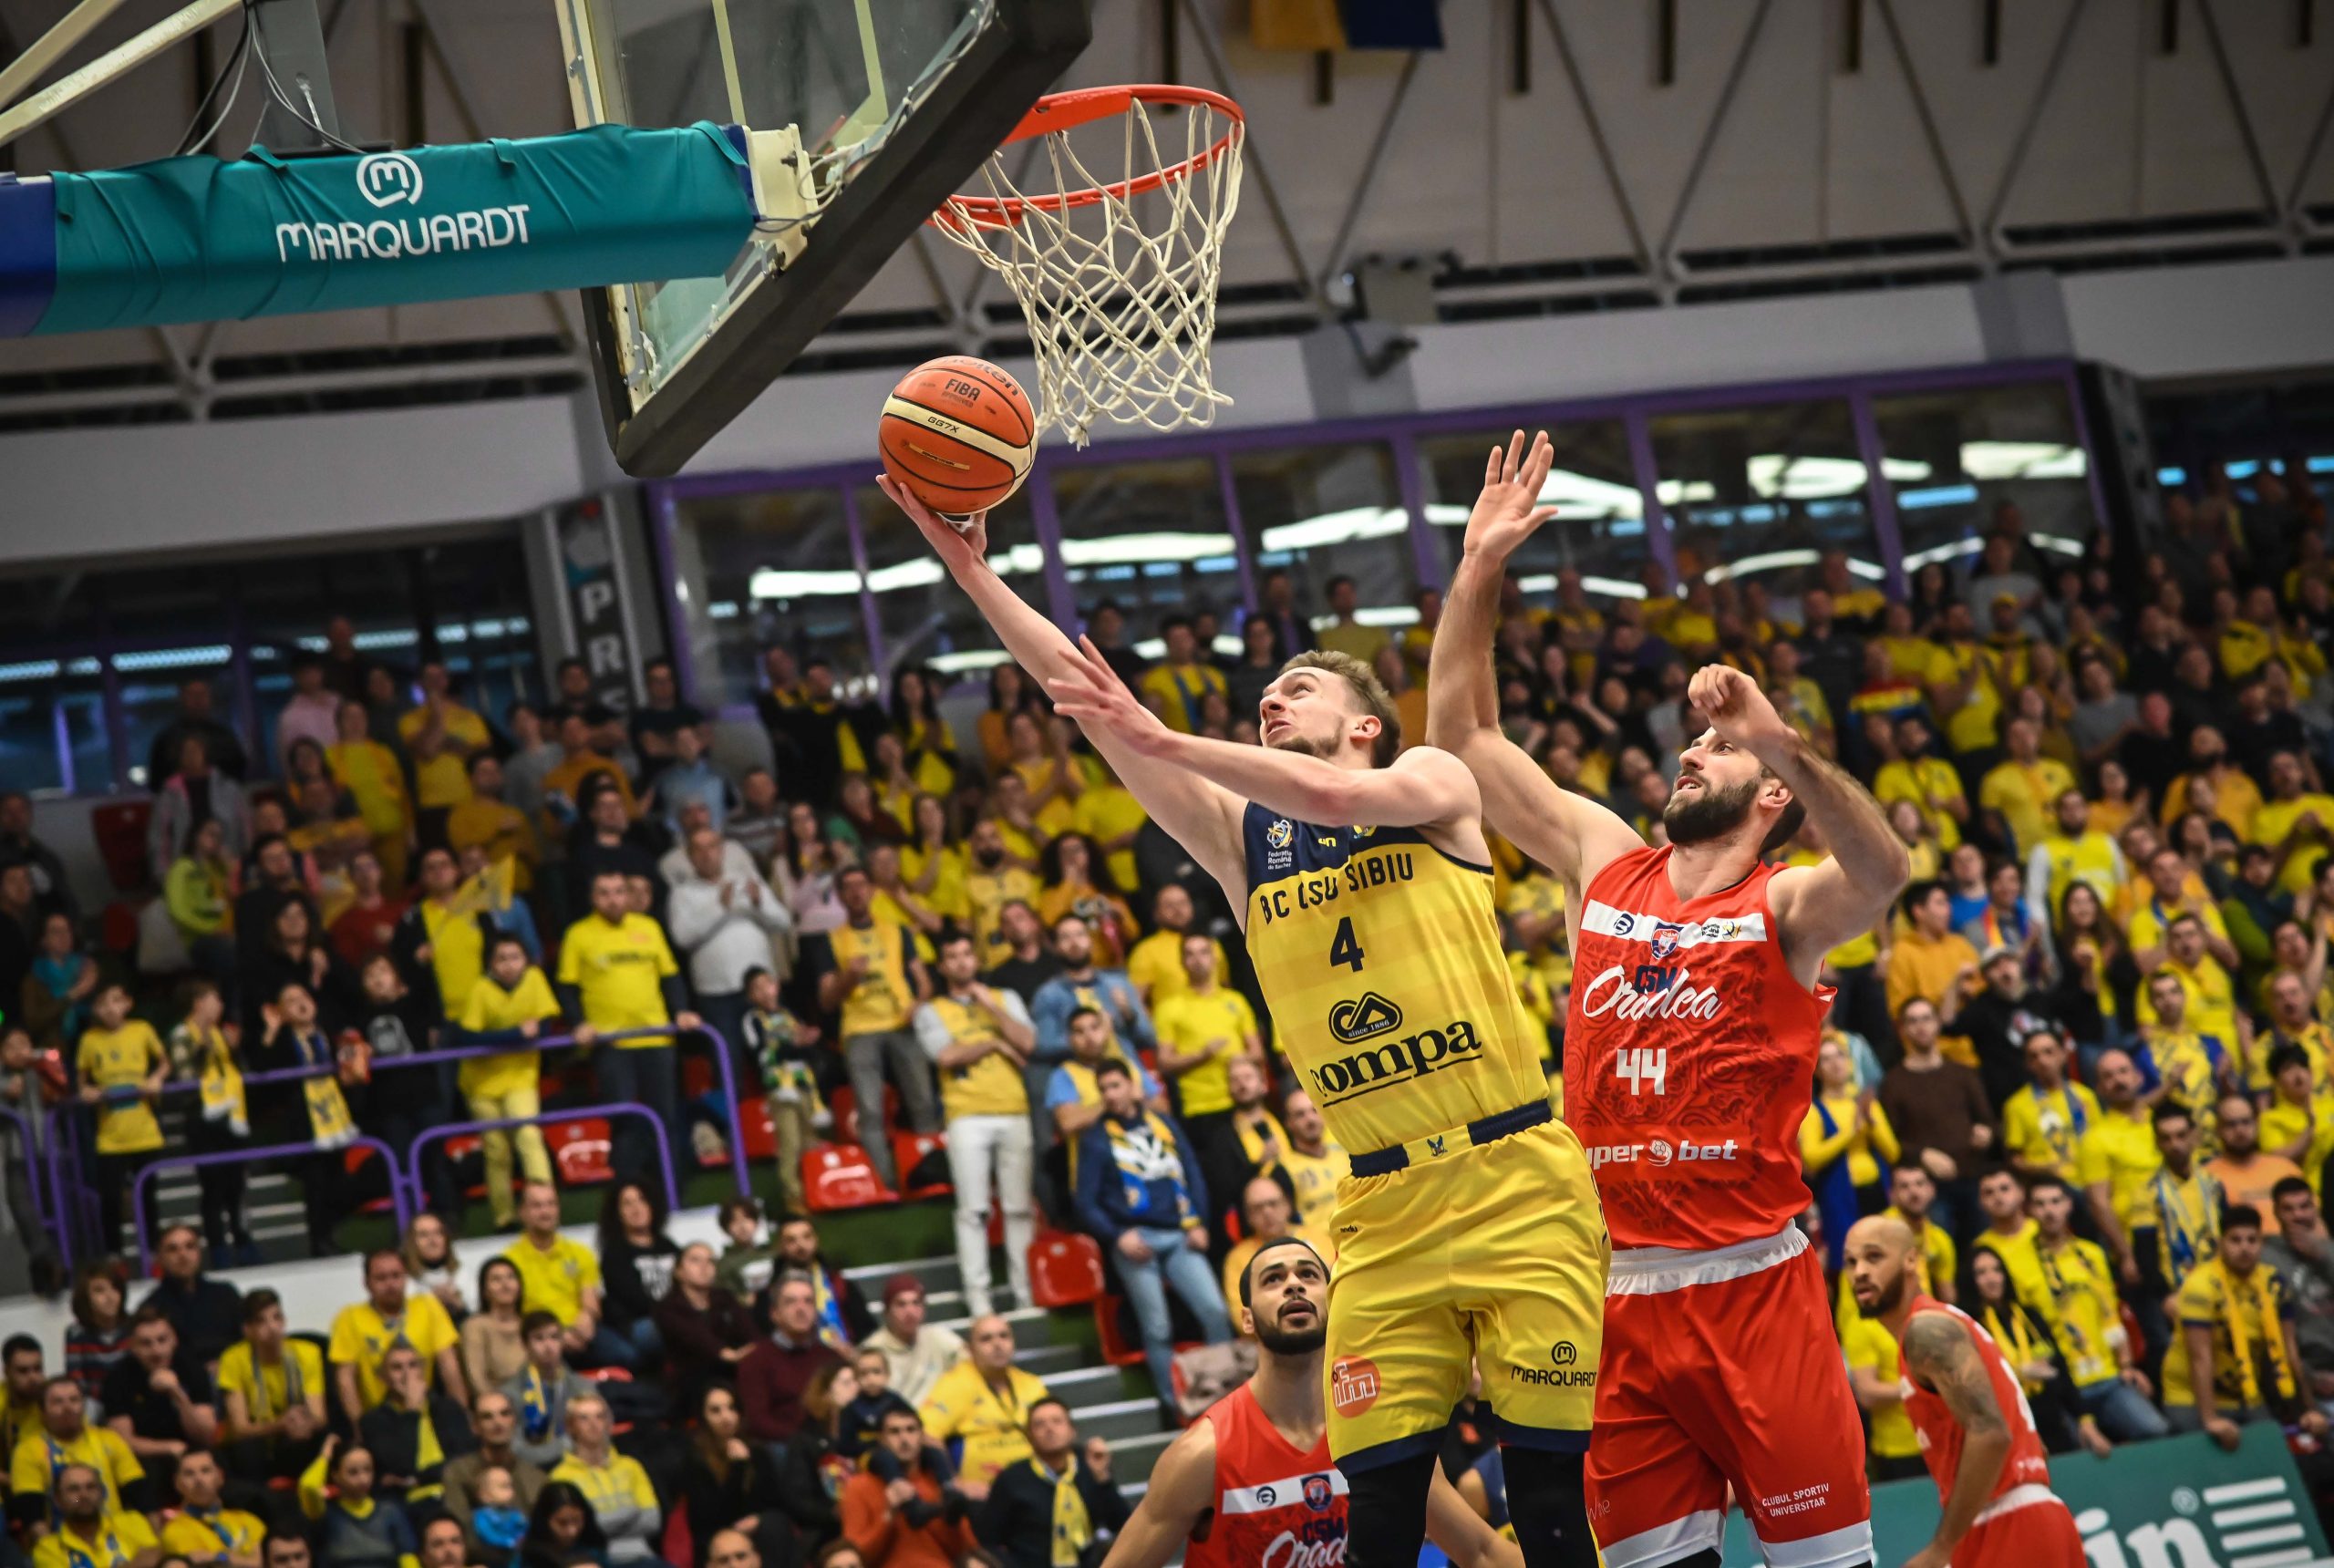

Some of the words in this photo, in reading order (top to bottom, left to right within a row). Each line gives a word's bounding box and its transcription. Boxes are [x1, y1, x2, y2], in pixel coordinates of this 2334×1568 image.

[275, 204, 530, 263] MARQUARDT
[945, 378, 982, 402] FIBA
[927, 416, 960, 433] GG7X
[1259, 890, 1290, 926] BC
[1297, 875, 1339, 910] CSU
[1345, 852, 1414, 892] SIBIU
[1329, 916, 1365, 973] 4
[1583, 965, 1723, 1021] Oradea
[1348, 1026, 1368, 1038] since
[1370, 1018, 1390, 1031] 1886
[1616, 1047, 1667, 1096] 44
[1678, 1140, 1739, 1161] bet
[1761, 1493, 1792, 1507] CLUBUL
[1792, 1482, 1829, 1501] SPORTIV
[1770, 1497, 1826, 1517] UNIVERSITAR
[1262, 1530, 1348, 1568] Orad
